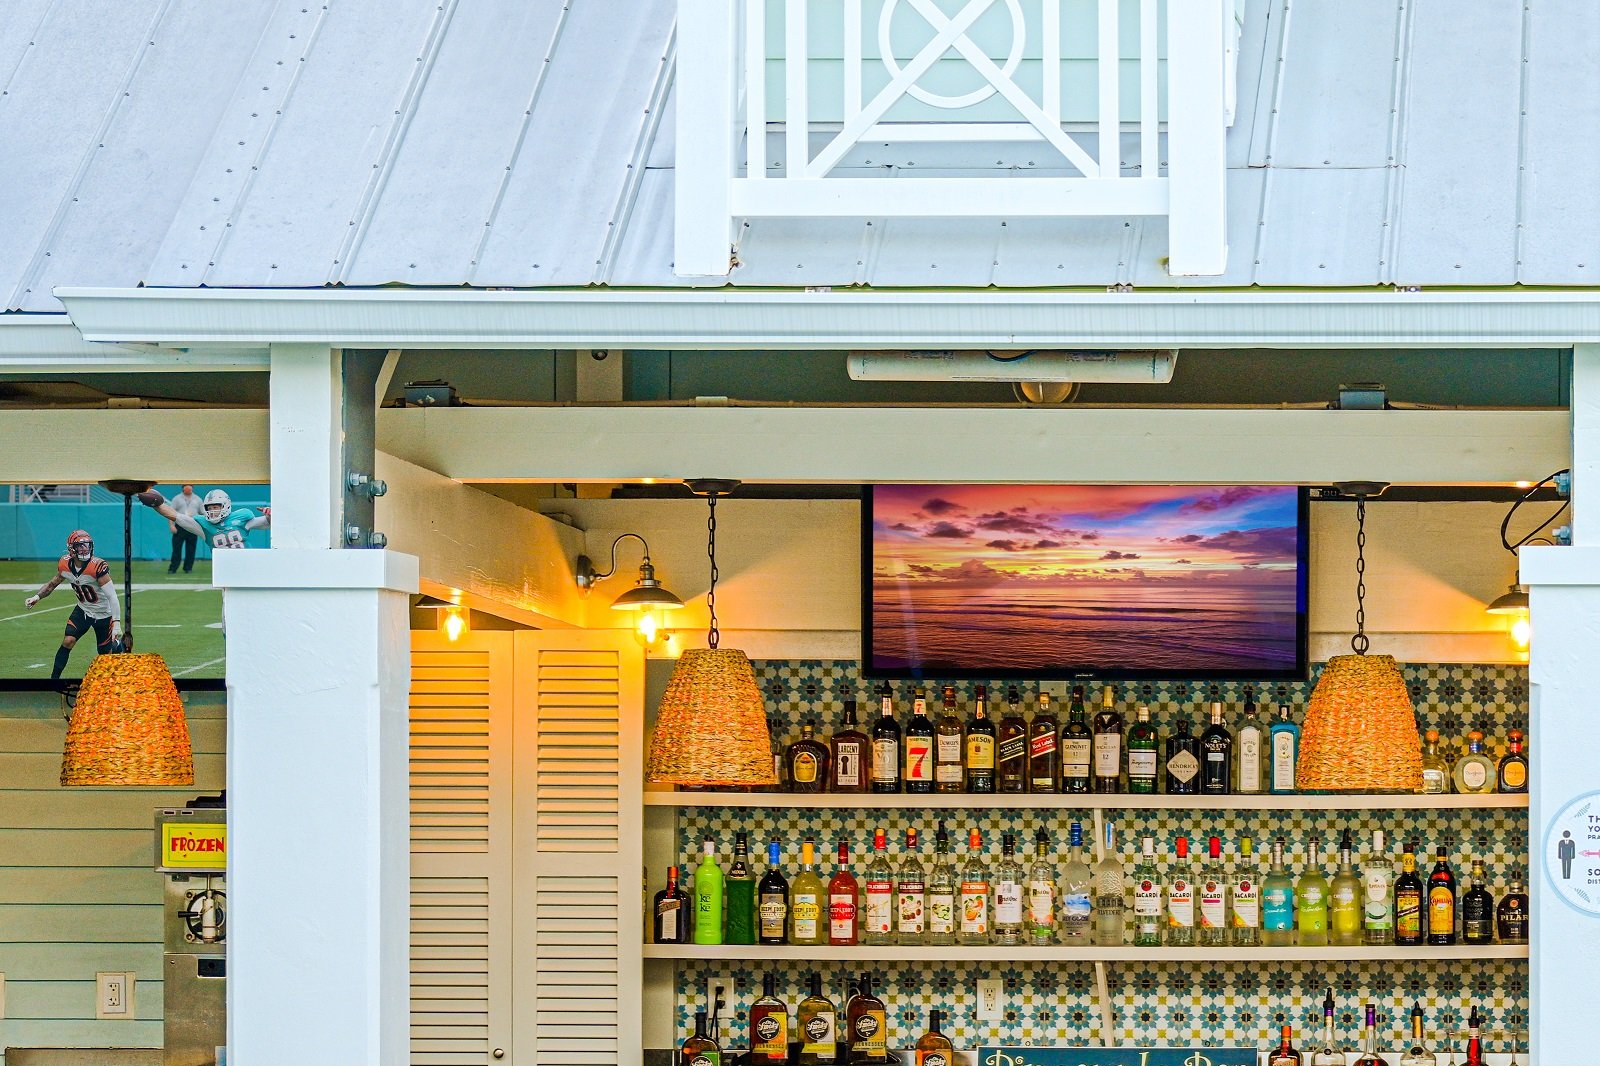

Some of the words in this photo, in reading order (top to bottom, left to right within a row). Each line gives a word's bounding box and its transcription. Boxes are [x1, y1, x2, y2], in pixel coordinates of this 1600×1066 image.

[838, 745, 858, 754] LARCENY
[909, 747, 929, 778] 7
[171, 836, 225, 853] FROZEN
